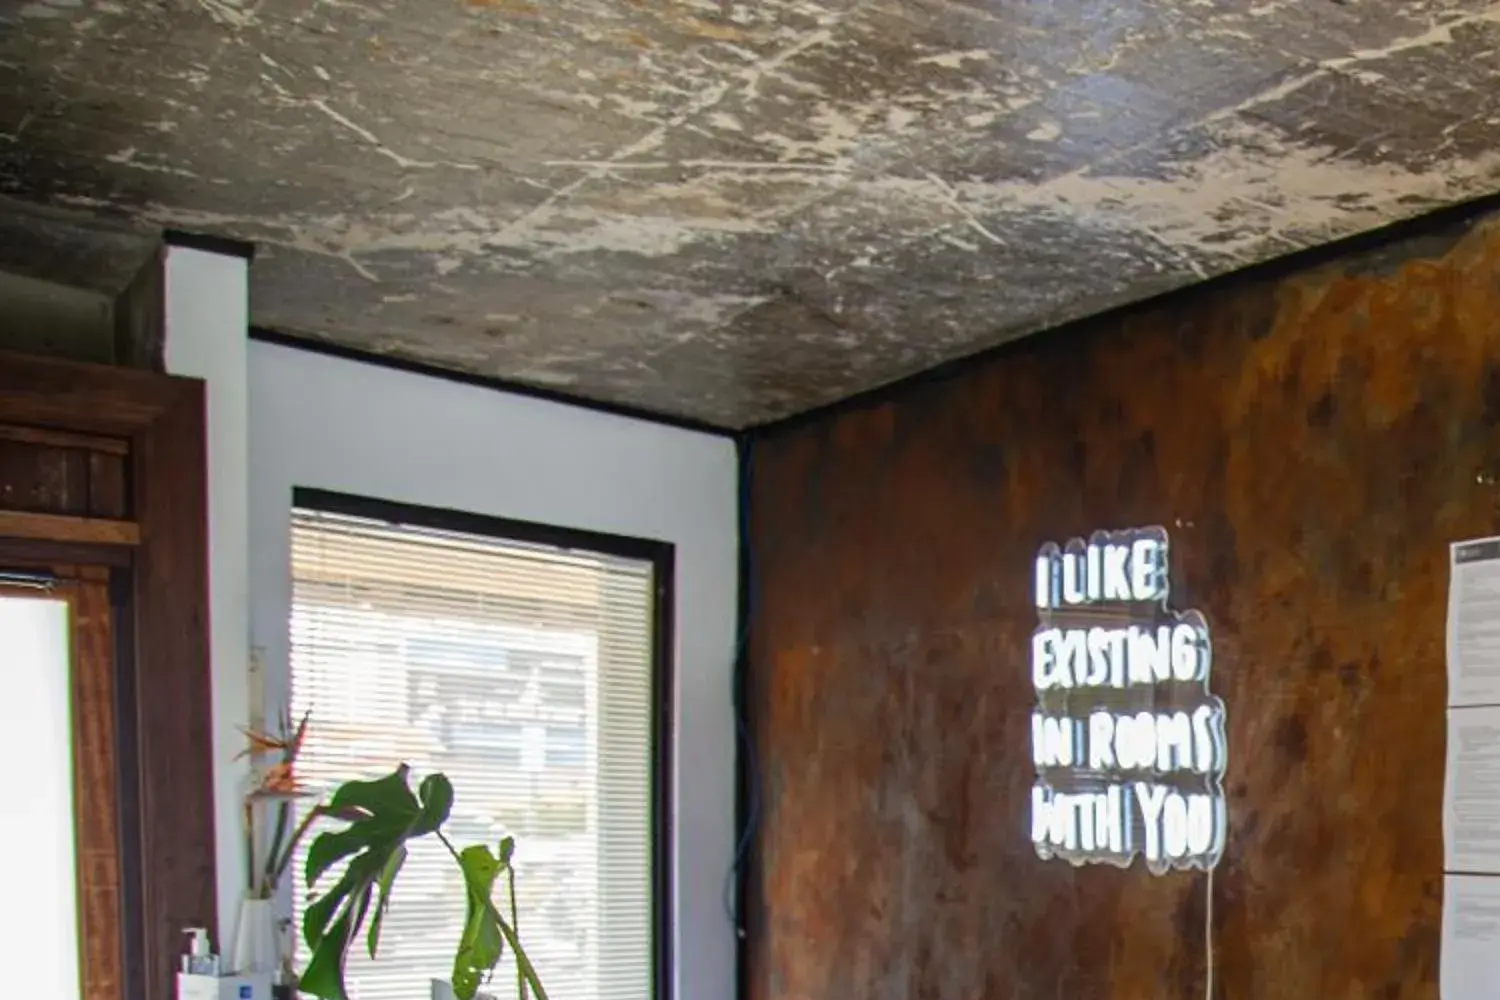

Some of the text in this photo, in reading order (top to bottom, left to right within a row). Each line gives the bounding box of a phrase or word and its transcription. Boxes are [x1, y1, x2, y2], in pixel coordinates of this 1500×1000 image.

[1035, 538, 1158, 609] I LIKE
[1032, 622, 1199, 690] EXISTING
[1031, 704, 1213, 772] IN ROOMS
[1031, 780, 1212, 861] WITH YOU
